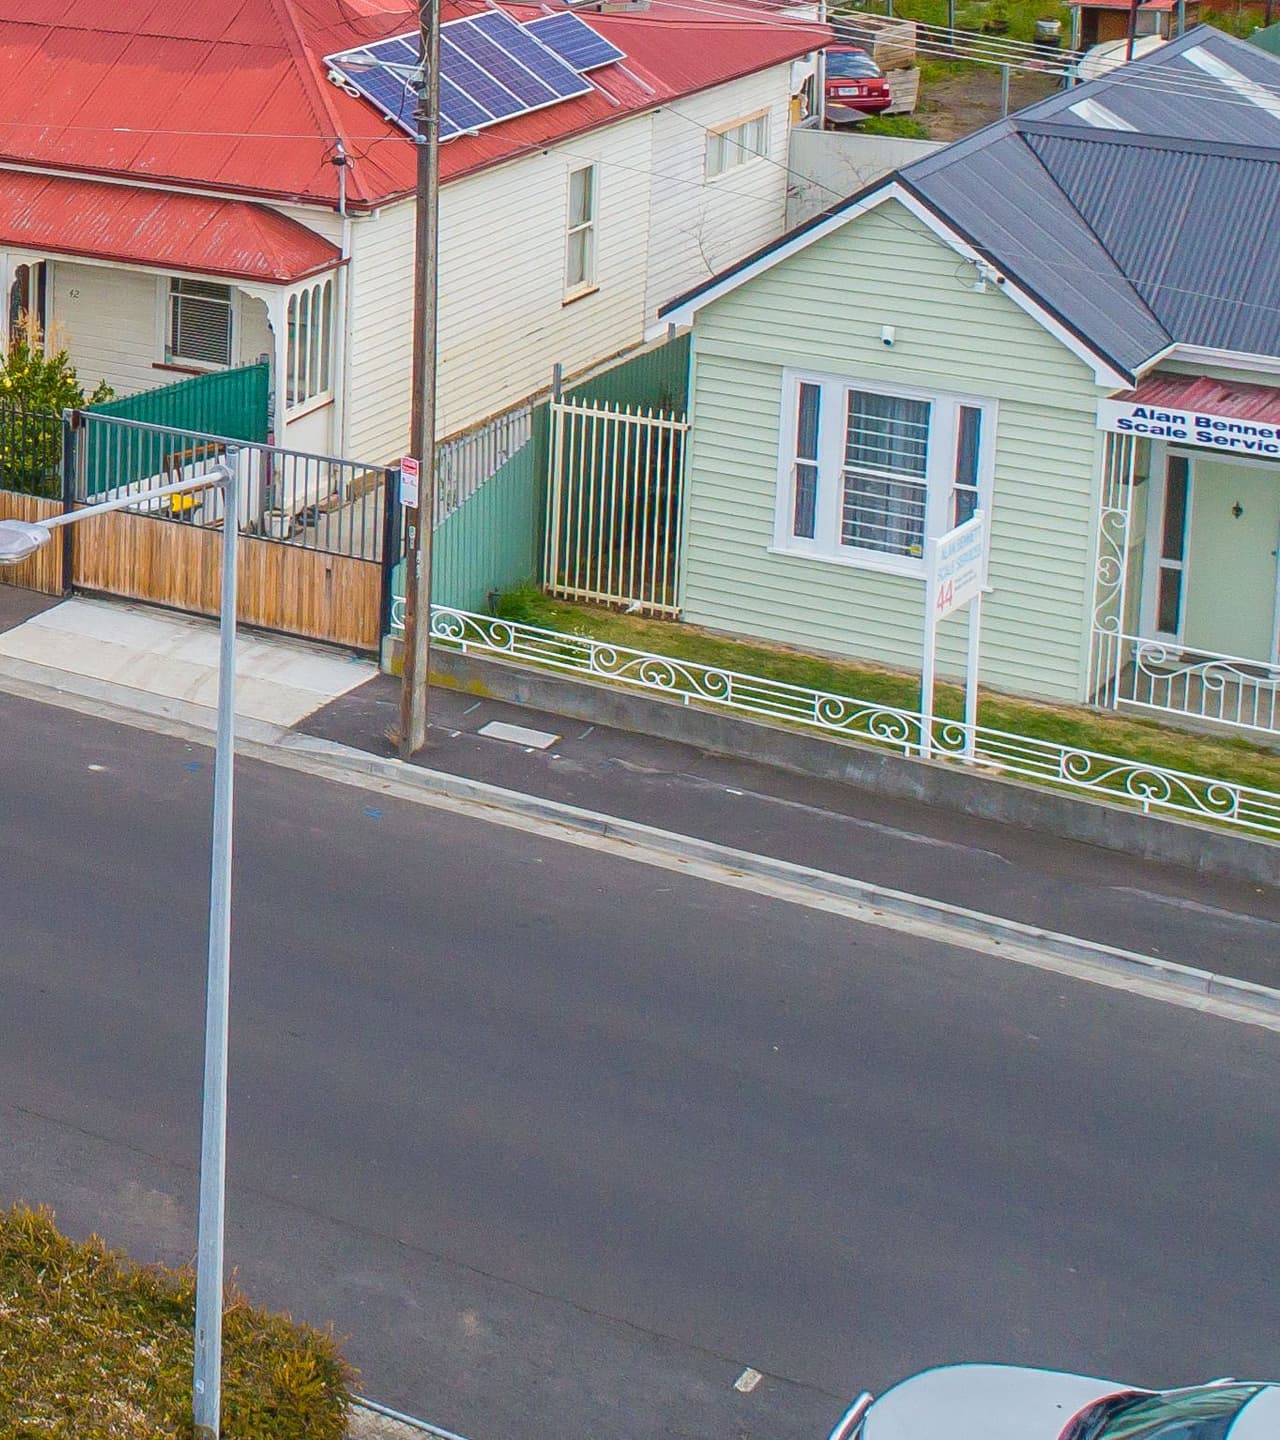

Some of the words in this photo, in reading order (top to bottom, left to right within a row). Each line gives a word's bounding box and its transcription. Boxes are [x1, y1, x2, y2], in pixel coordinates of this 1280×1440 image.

[1132, 407, 1186, 425] Alan
[1117, 418, 1188, 439] Scale
[1196, 430, 1279, 454] Servic
[936, 579, 953, 612] 44
